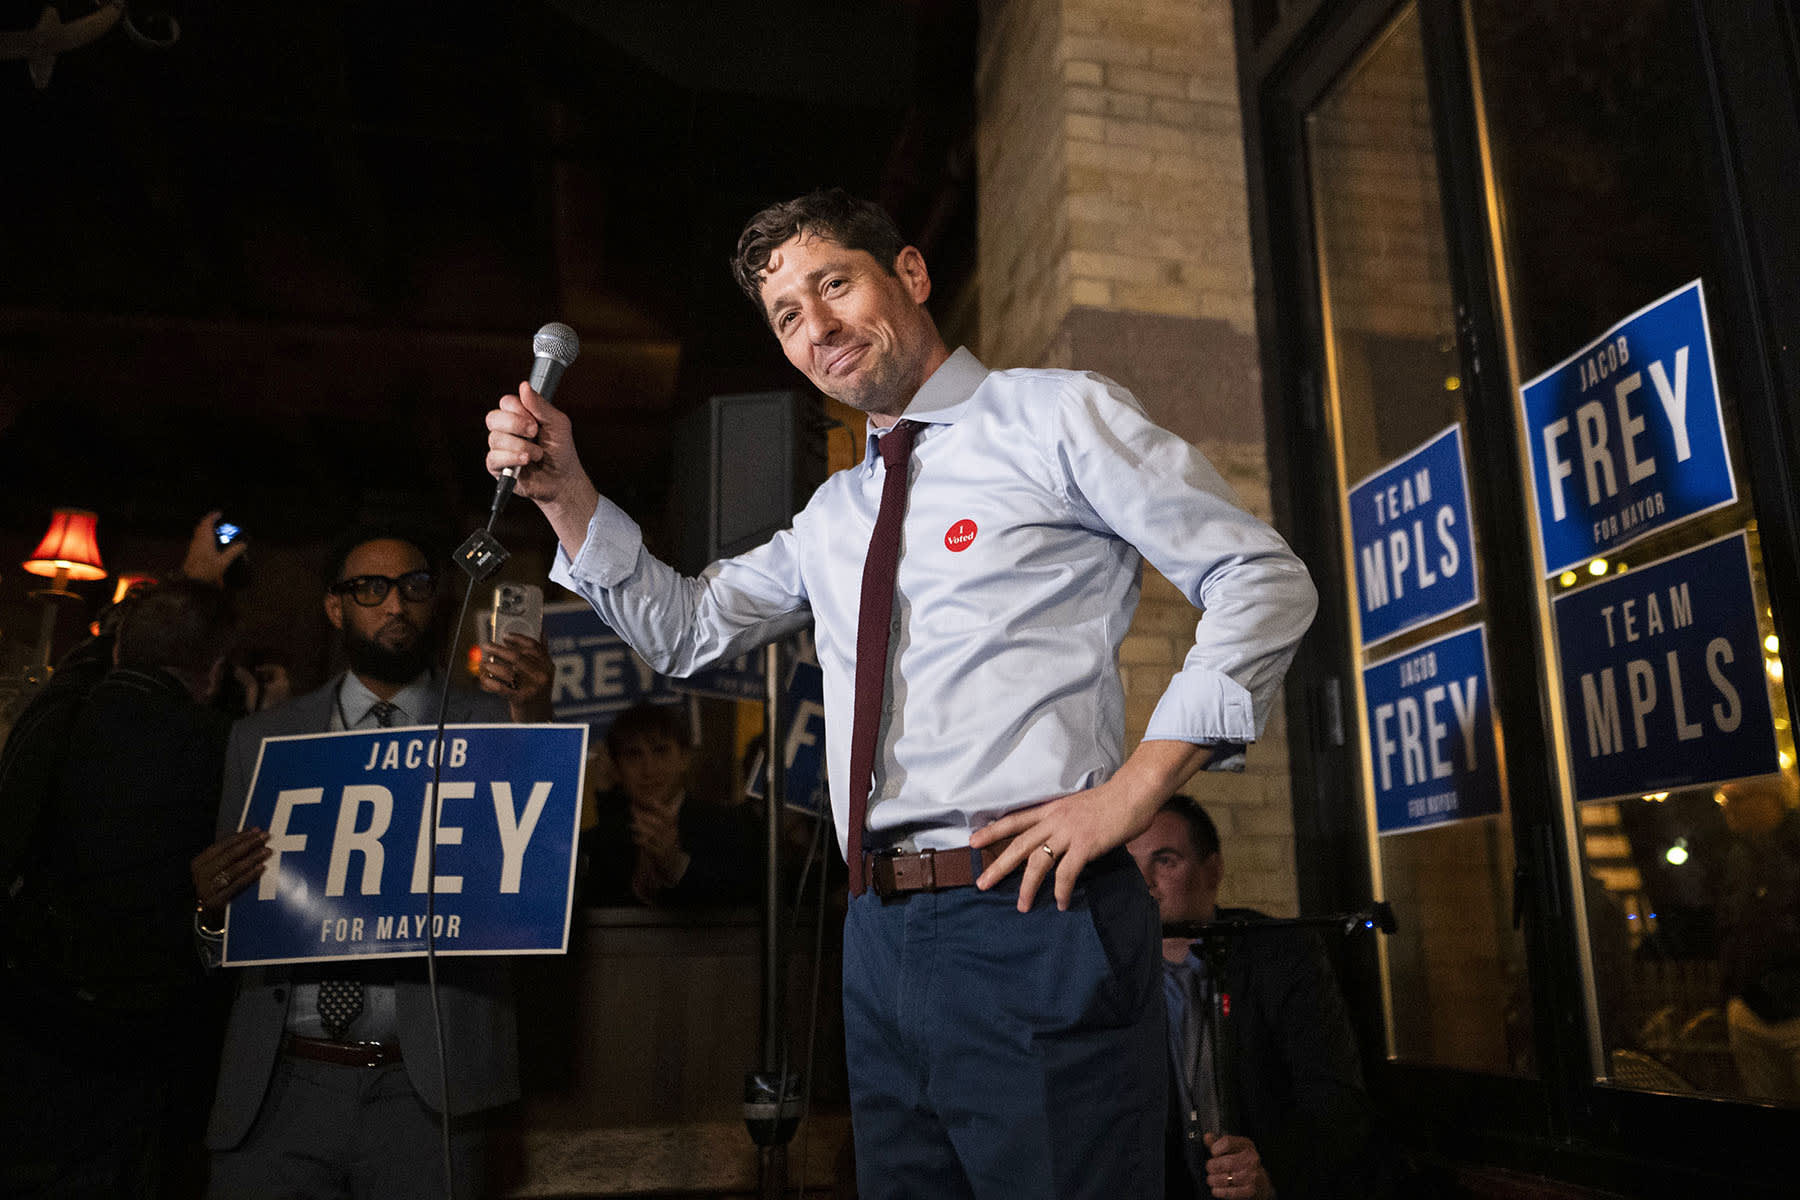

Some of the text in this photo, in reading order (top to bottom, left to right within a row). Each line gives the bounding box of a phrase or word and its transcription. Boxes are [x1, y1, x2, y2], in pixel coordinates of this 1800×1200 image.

[1579, 335, 1631, 392] JACOB
[1543, 345, 1692, 523] FREY
[1374, 466, 1433, 526] TEAM
[1593, 513, 1618, 545] FOR
[1621, 491, 1665, 532] MAYOR
[948, 531, 974, 545] Voted
[959, 525, 964, 534] I
[1362, 504, 1460, 613] MPLS
[1601, 582, 1693, 648] TEAM
[551, 648, 655, 701] REY
[1580, 636, 1743, 759] MPLS
[364, 738, 468, 771] JACOB
[1375, 675, 1479, 792] FREY
[258, 781, 553, 900] FREY
[321, 914, 461, 943] FOR MAYOR
